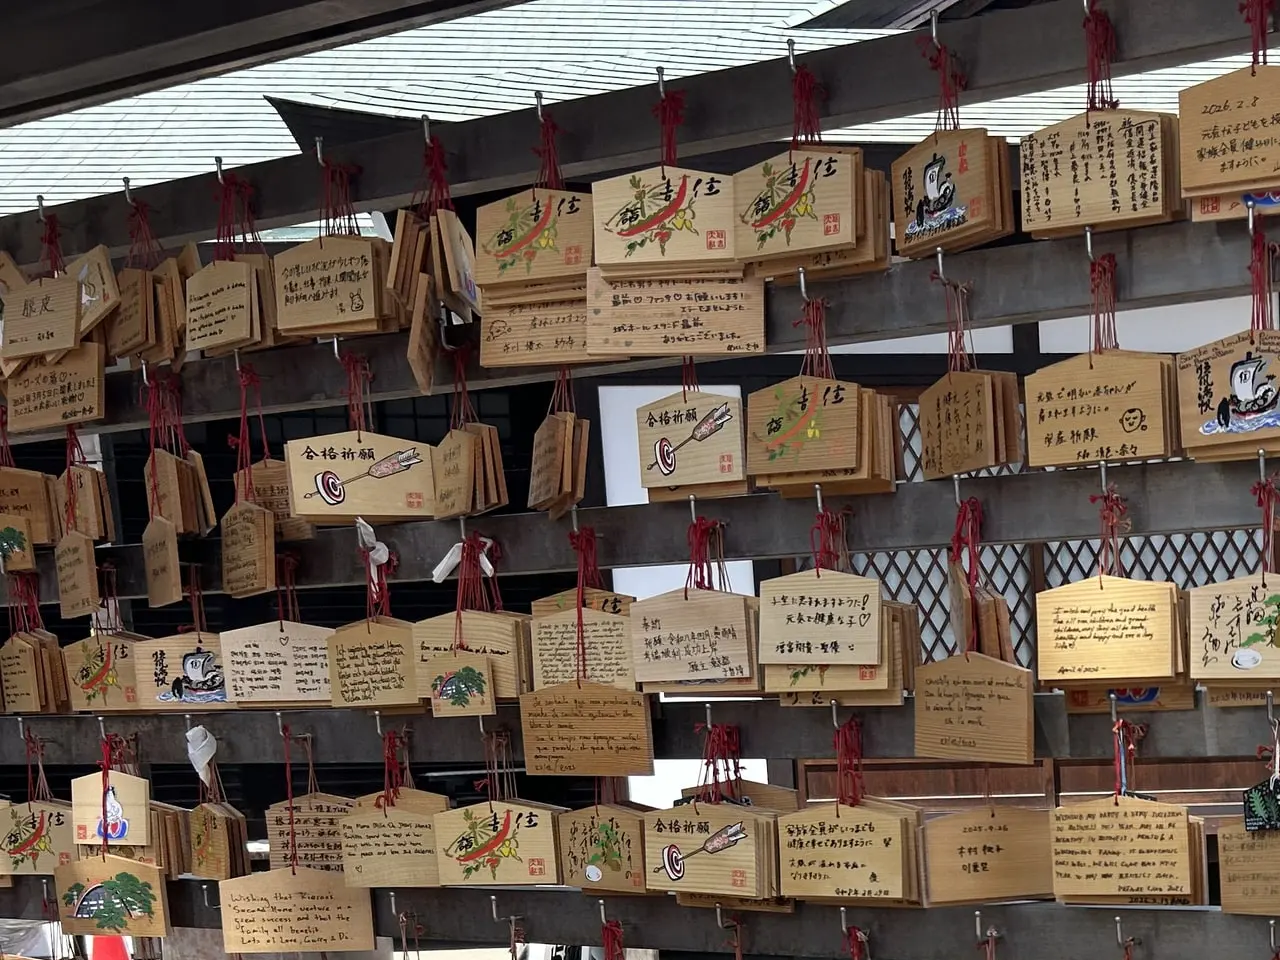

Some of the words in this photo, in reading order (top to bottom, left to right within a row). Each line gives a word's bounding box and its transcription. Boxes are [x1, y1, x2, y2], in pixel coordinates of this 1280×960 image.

[647, 408, 698, 427] 合格祈願
[300, 445, 375, 463] 合格祈願
[654, 819, 710, 834] 合格祈願
[231, 892, 270, 908] Wishing
[274, 892, 292, 901] that
